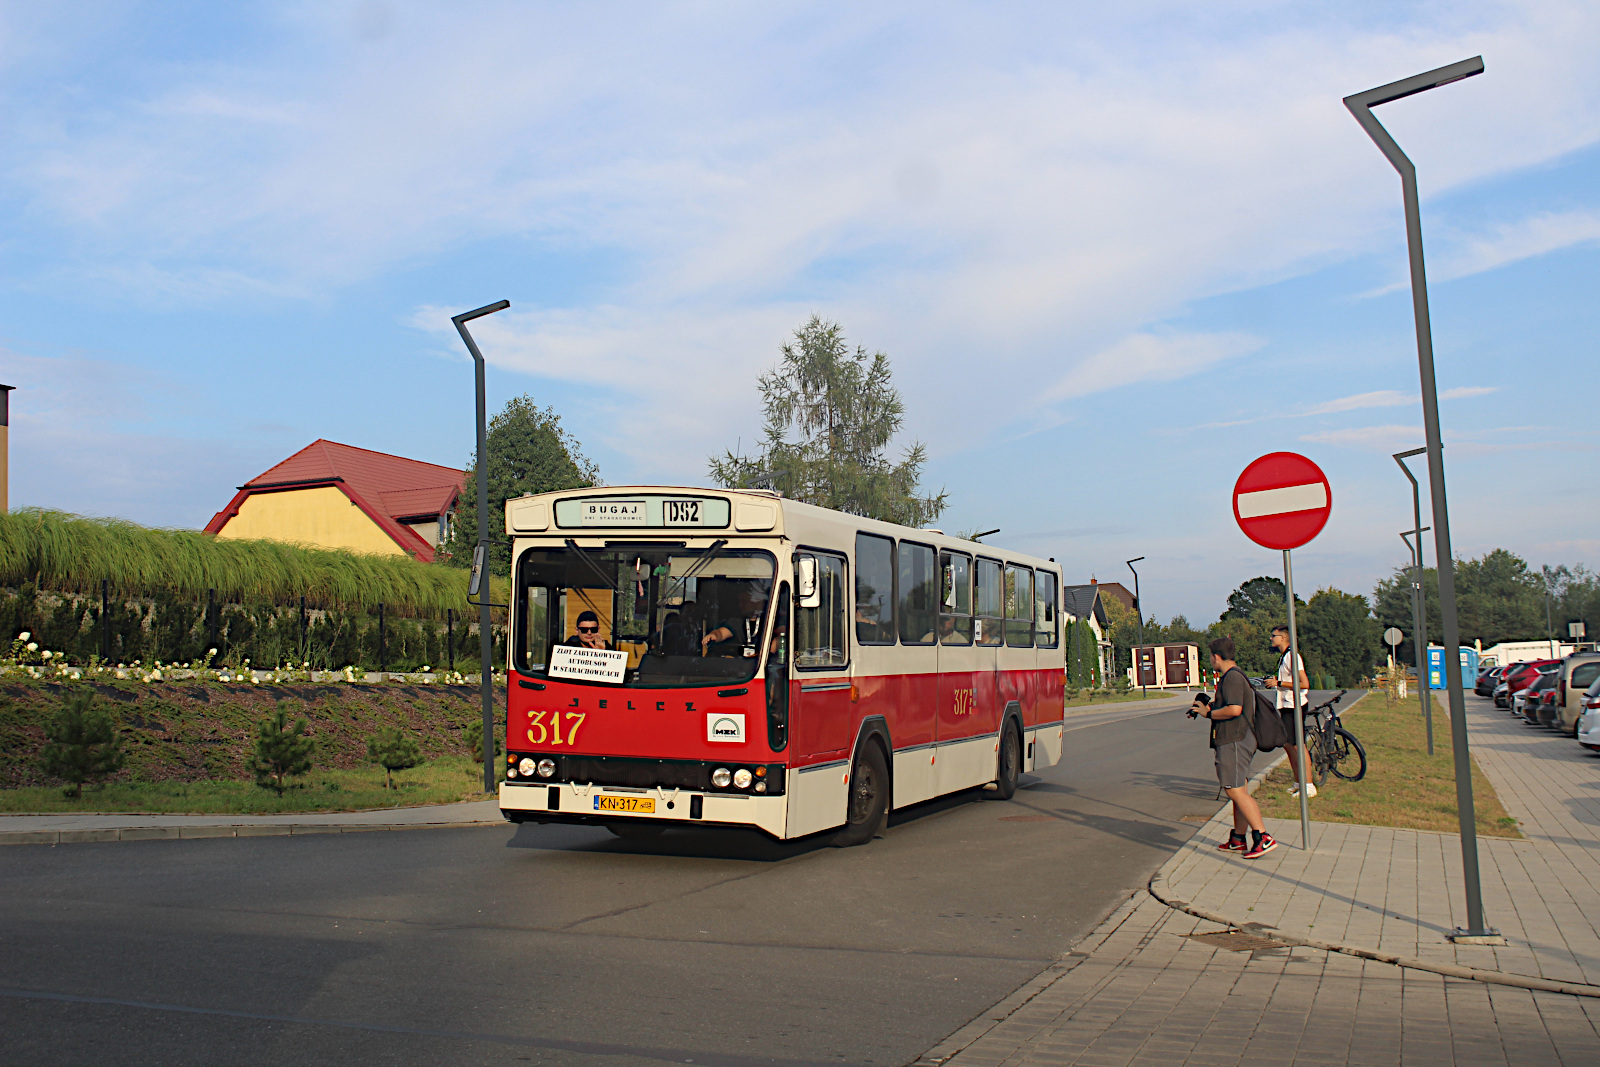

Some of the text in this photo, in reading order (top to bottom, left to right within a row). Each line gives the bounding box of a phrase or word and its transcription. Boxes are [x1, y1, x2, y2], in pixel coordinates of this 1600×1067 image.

[589, 505, 638, 514] BUGAJ
[669, 501, 699, 522] DS2
[573, 649, 622, 660] ZABYTKOWYCH
[568, 658, 608, 667] AUTOBUSÓW
[560, 666, 620, 678] STARACHOWICACH
[568, 698, 697, 711] JELCZ
[954, 688, 969, 715] 317
[527, 710, 586, 746] 317
